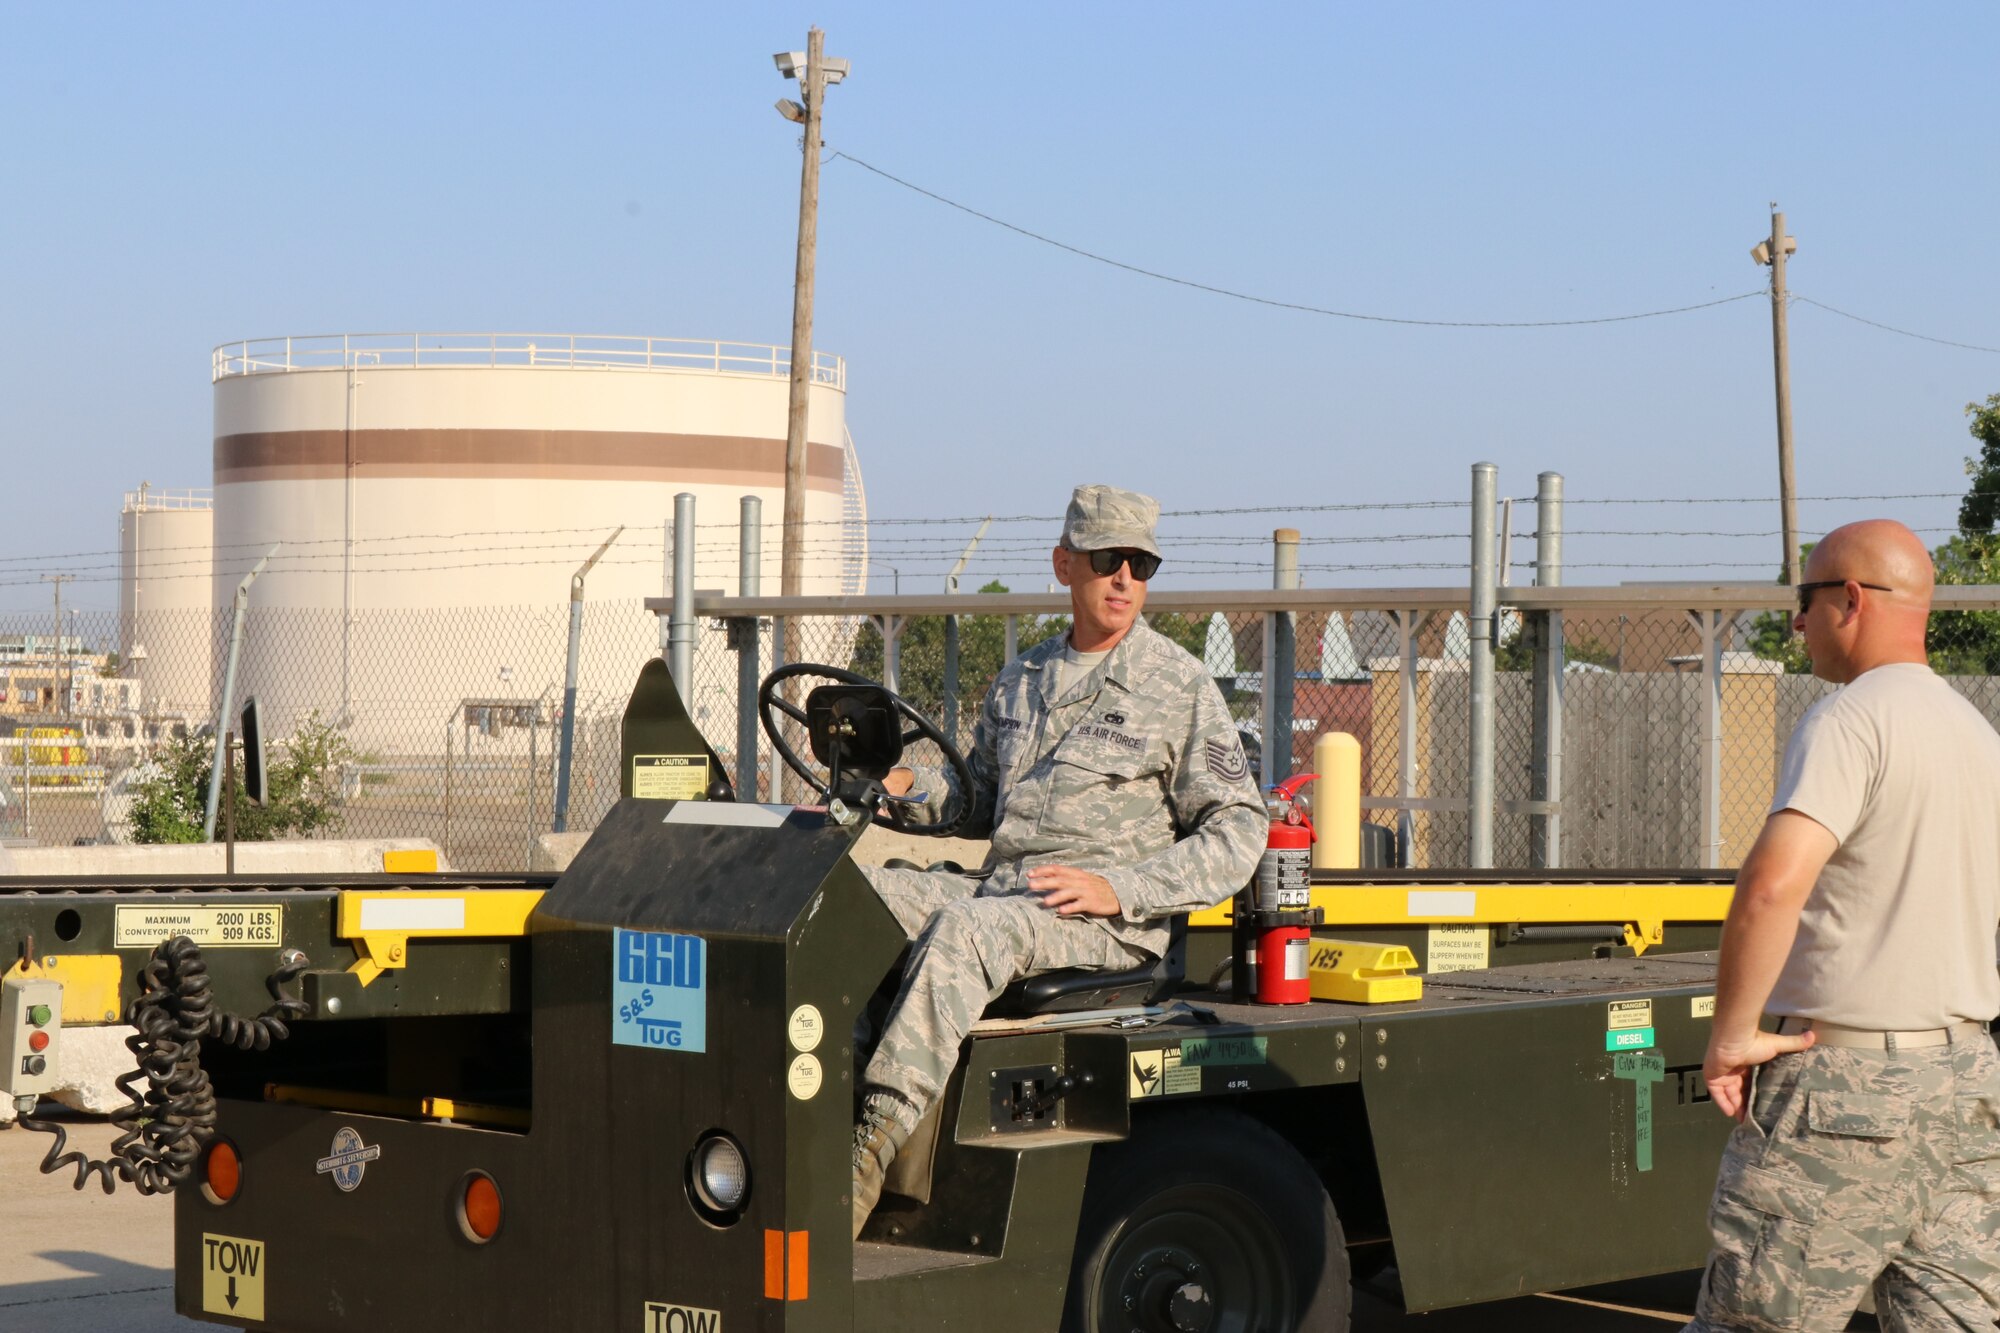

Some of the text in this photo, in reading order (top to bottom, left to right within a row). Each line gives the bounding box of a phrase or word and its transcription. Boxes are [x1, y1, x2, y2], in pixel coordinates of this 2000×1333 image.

[1092, 728, 1108, 740] AIR
[1110, 731, 1140, 748] FORCE
[660, 758, 688, 766] CAUTION
[145, 913, 275, 925] MAXIMUM 2000 LBS.
[125, 927, 275, 940] CONVEYOR CAPACITY 909 KGS.
[1441, 923, 1475, 934] CAUTION
[619, 930, 700, 989] 660
[620, 988, 654, 1023] S&S
[1622, 1002, 1647, 1010] DANGER
[802, 1019, 814, 1028] TUG
[636, 1017, 682, 1046] TUG
[1617, 1034, 1644, 1045] DIESEL
[800, 1068, 813, 1076] TUG
[205, 1239, 260, 1276] TOW
[649, 1304, 717, 1333] TOW
